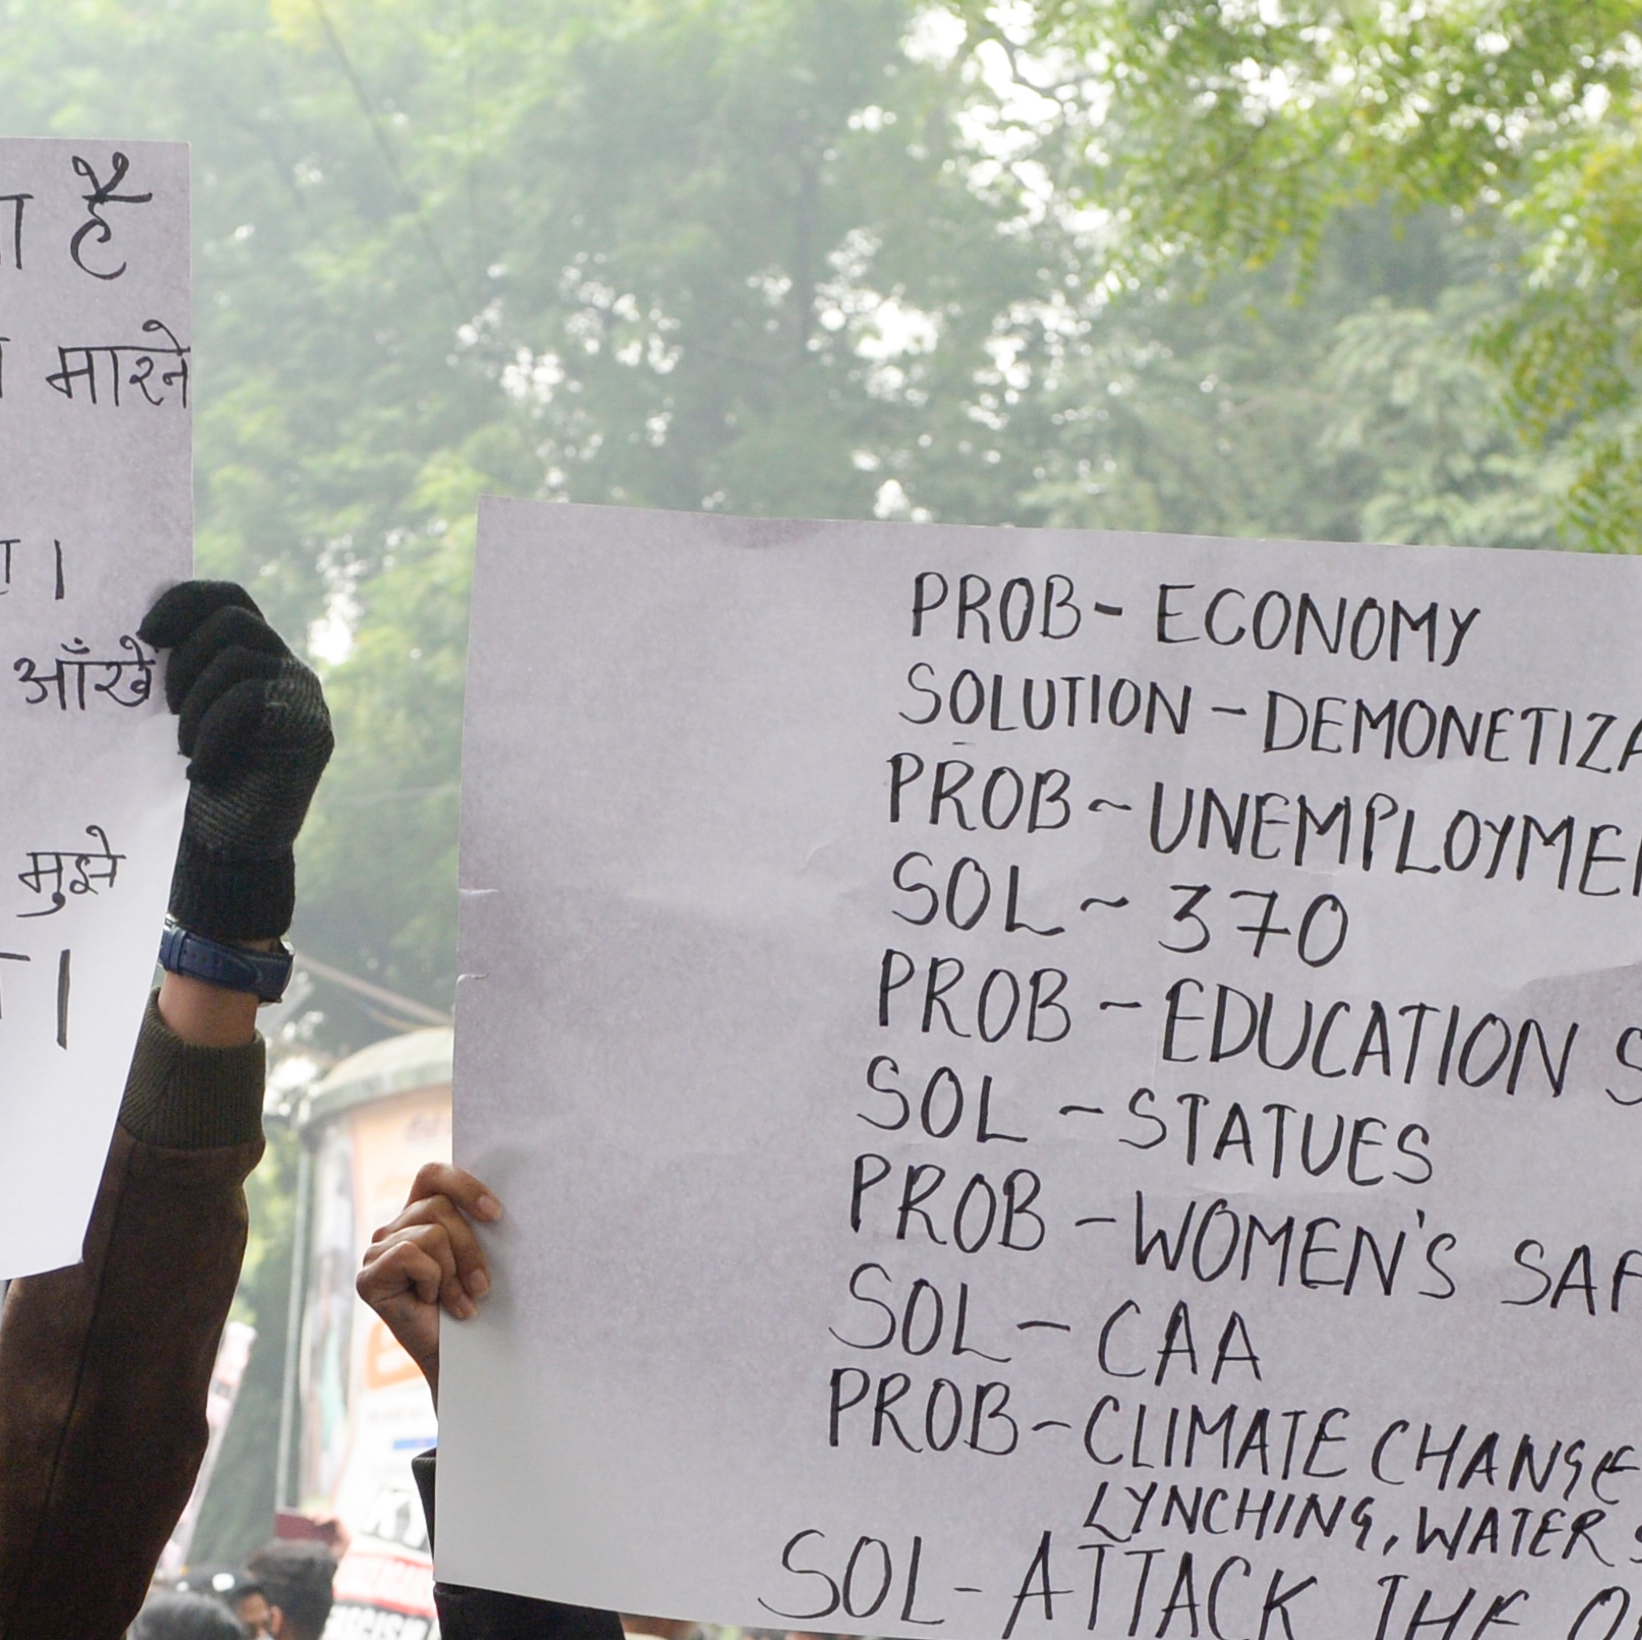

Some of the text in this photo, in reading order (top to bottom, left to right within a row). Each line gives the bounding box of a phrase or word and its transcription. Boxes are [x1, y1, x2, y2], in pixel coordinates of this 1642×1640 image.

[68, 150, 155, 282] है
[43, 317, 193, 410] मारने
[1155, 582, 1483, 669] ECONOMY
[15, 823, 128, 919] मुझे
[1156, 882, 1350, 970] 370
[1160, 976, 1581, 1100] EDUCATION
[1117, 1086, 1434, 1188] STATUES
[1096, 1297, 1264, 1388] CAA
[1082, 1393, 1352, 1482] CLIMATE
[1414, 1504, 1617, 1569] WATER
